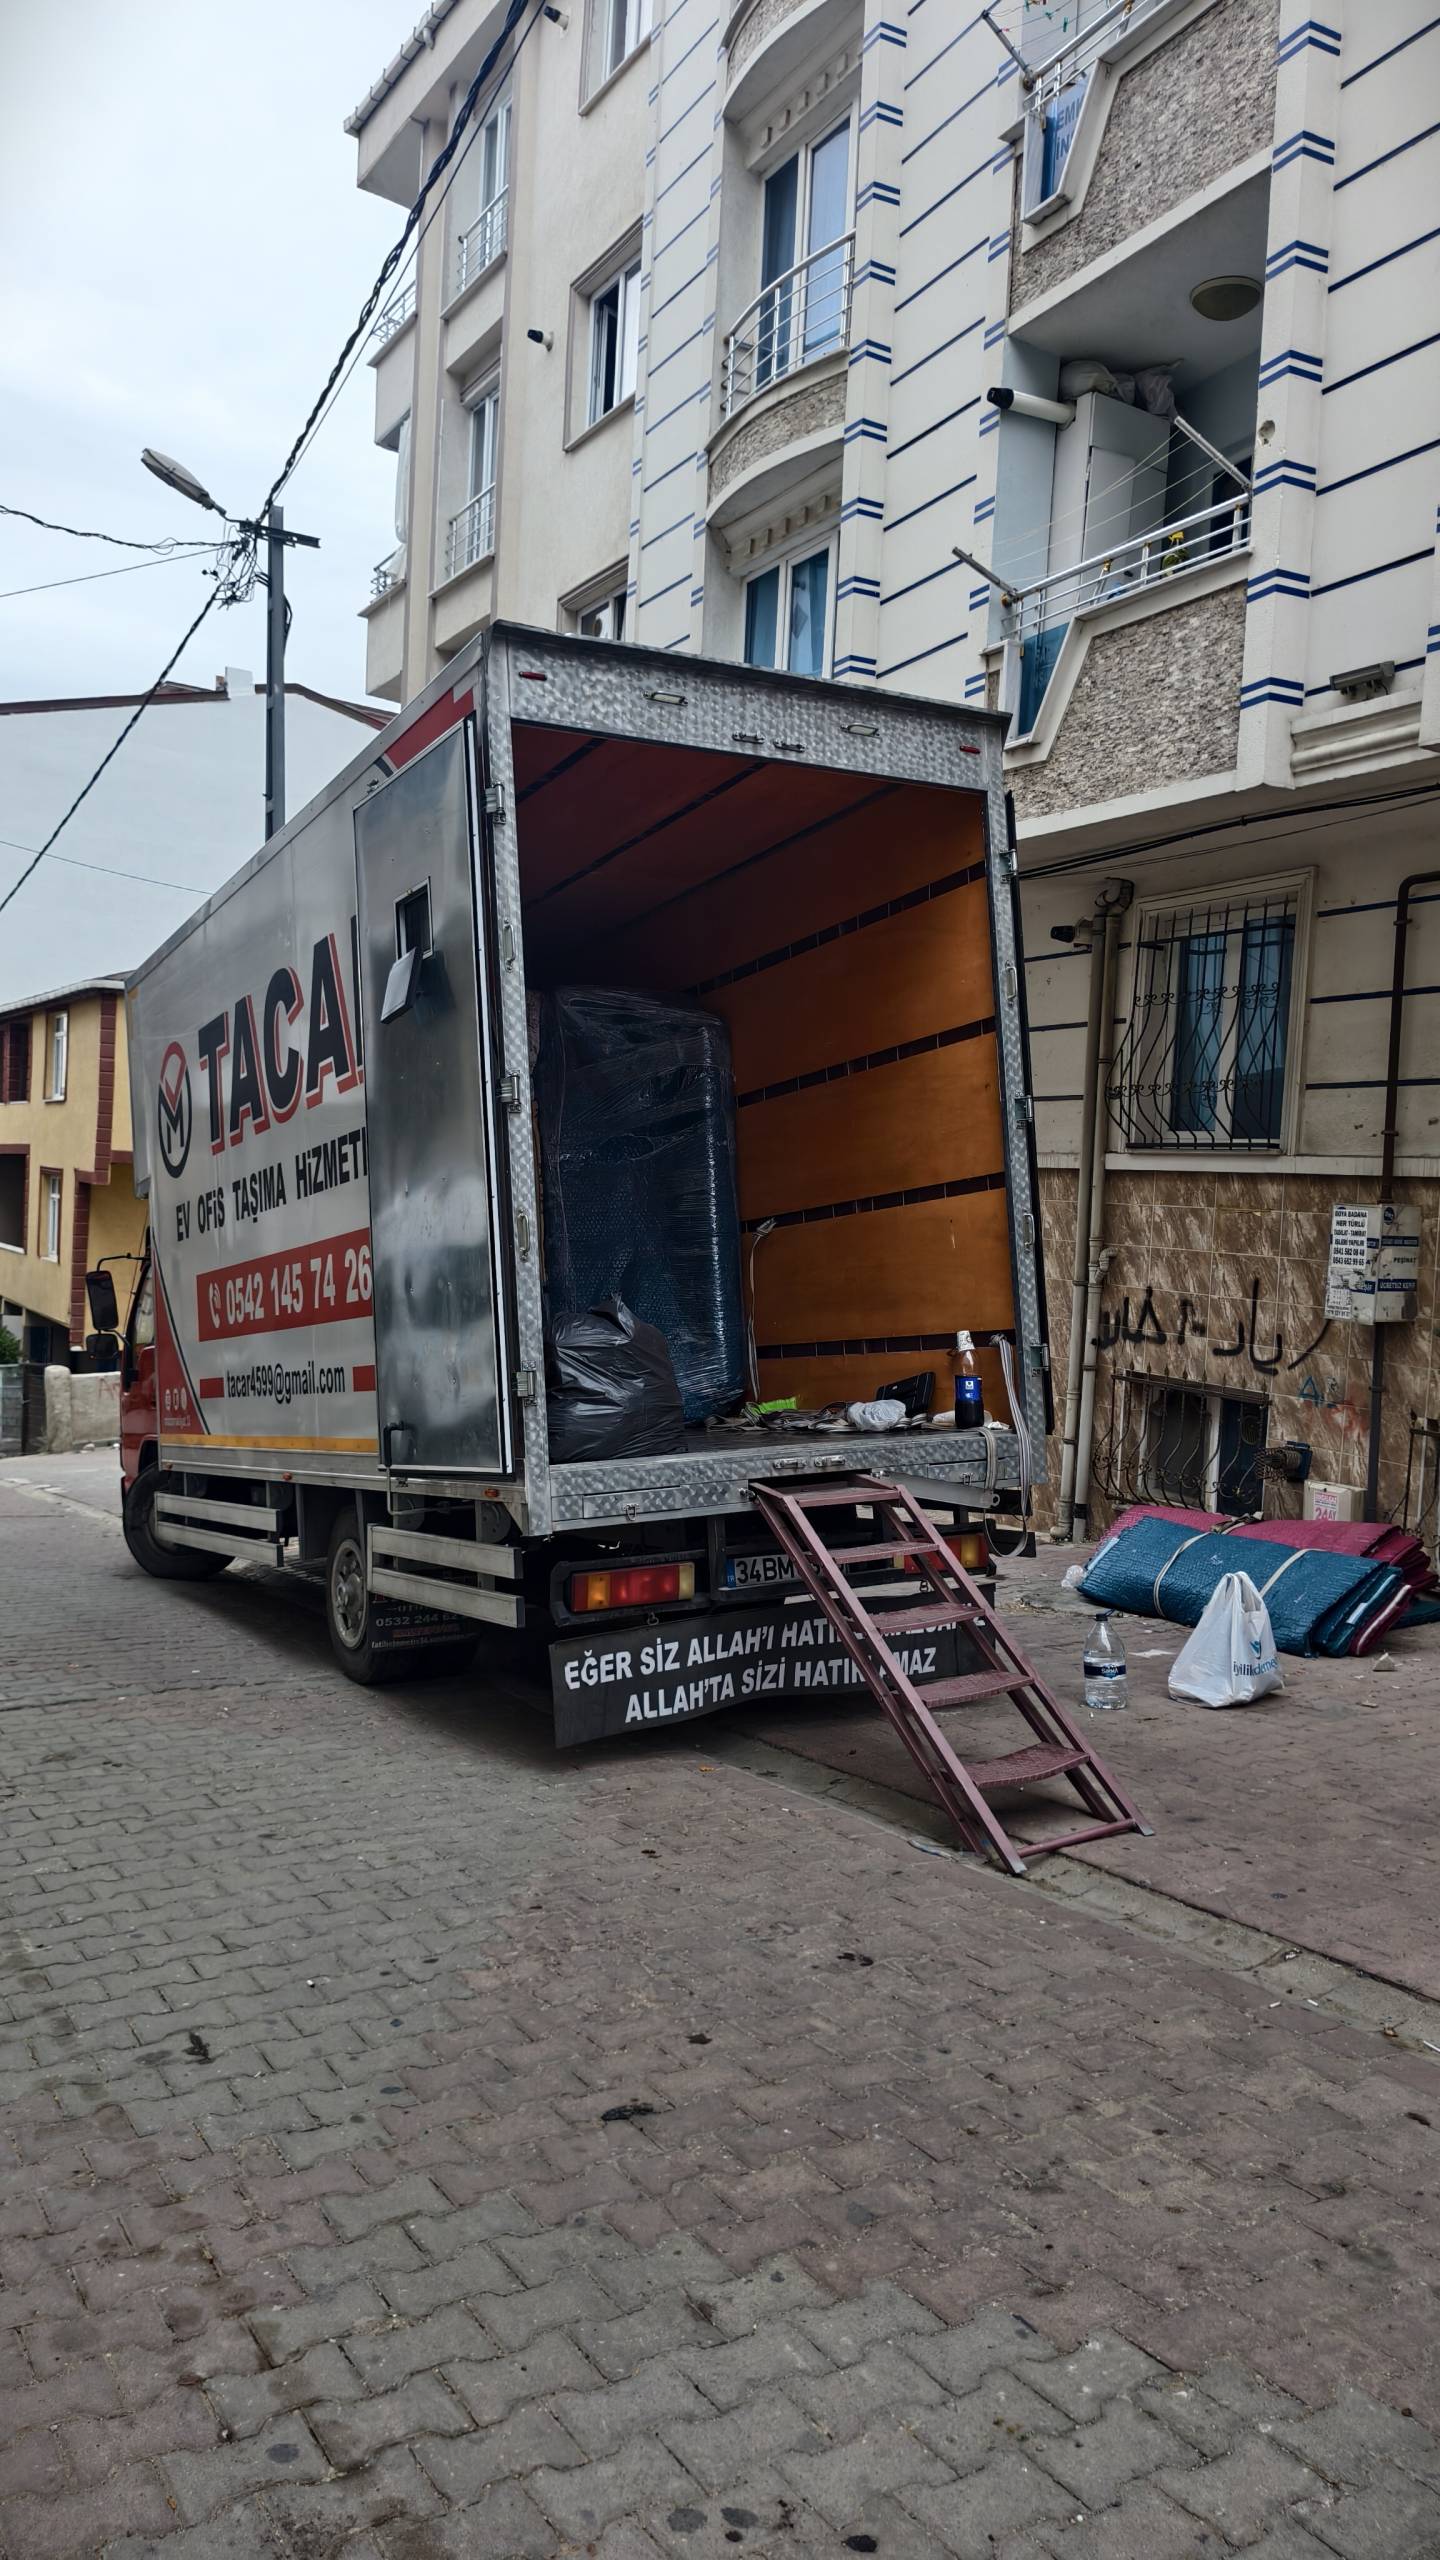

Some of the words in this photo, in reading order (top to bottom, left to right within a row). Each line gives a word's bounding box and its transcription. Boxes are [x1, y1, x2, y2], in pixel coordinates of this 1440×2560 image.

[176, 1200, 190, 1241] EV
[232, 1162, 287, 1223] TAŞIMA
[1335, 1219, 1347, 1227] HER
[226, 1272, 264, 1325] 0542
[270, 1262, 304, 1316] 145
[310, 1253, 336, 1308] 74
[345, 1244, 372, 1303] 26
[227, 1361, 346, 1404] tacar4599@gmail.com
[375, 1615, 410, 1628] 0532
[564, 1650, 633, 1690] EĞER
[640, 1638, 680, 1675] SİZ
[687, 1625, 775, 1667] ALLAH'I
[625, 1673, 735, 1724] ALLAH'TA
[741, 1656, 785, 1694] SİZİ
